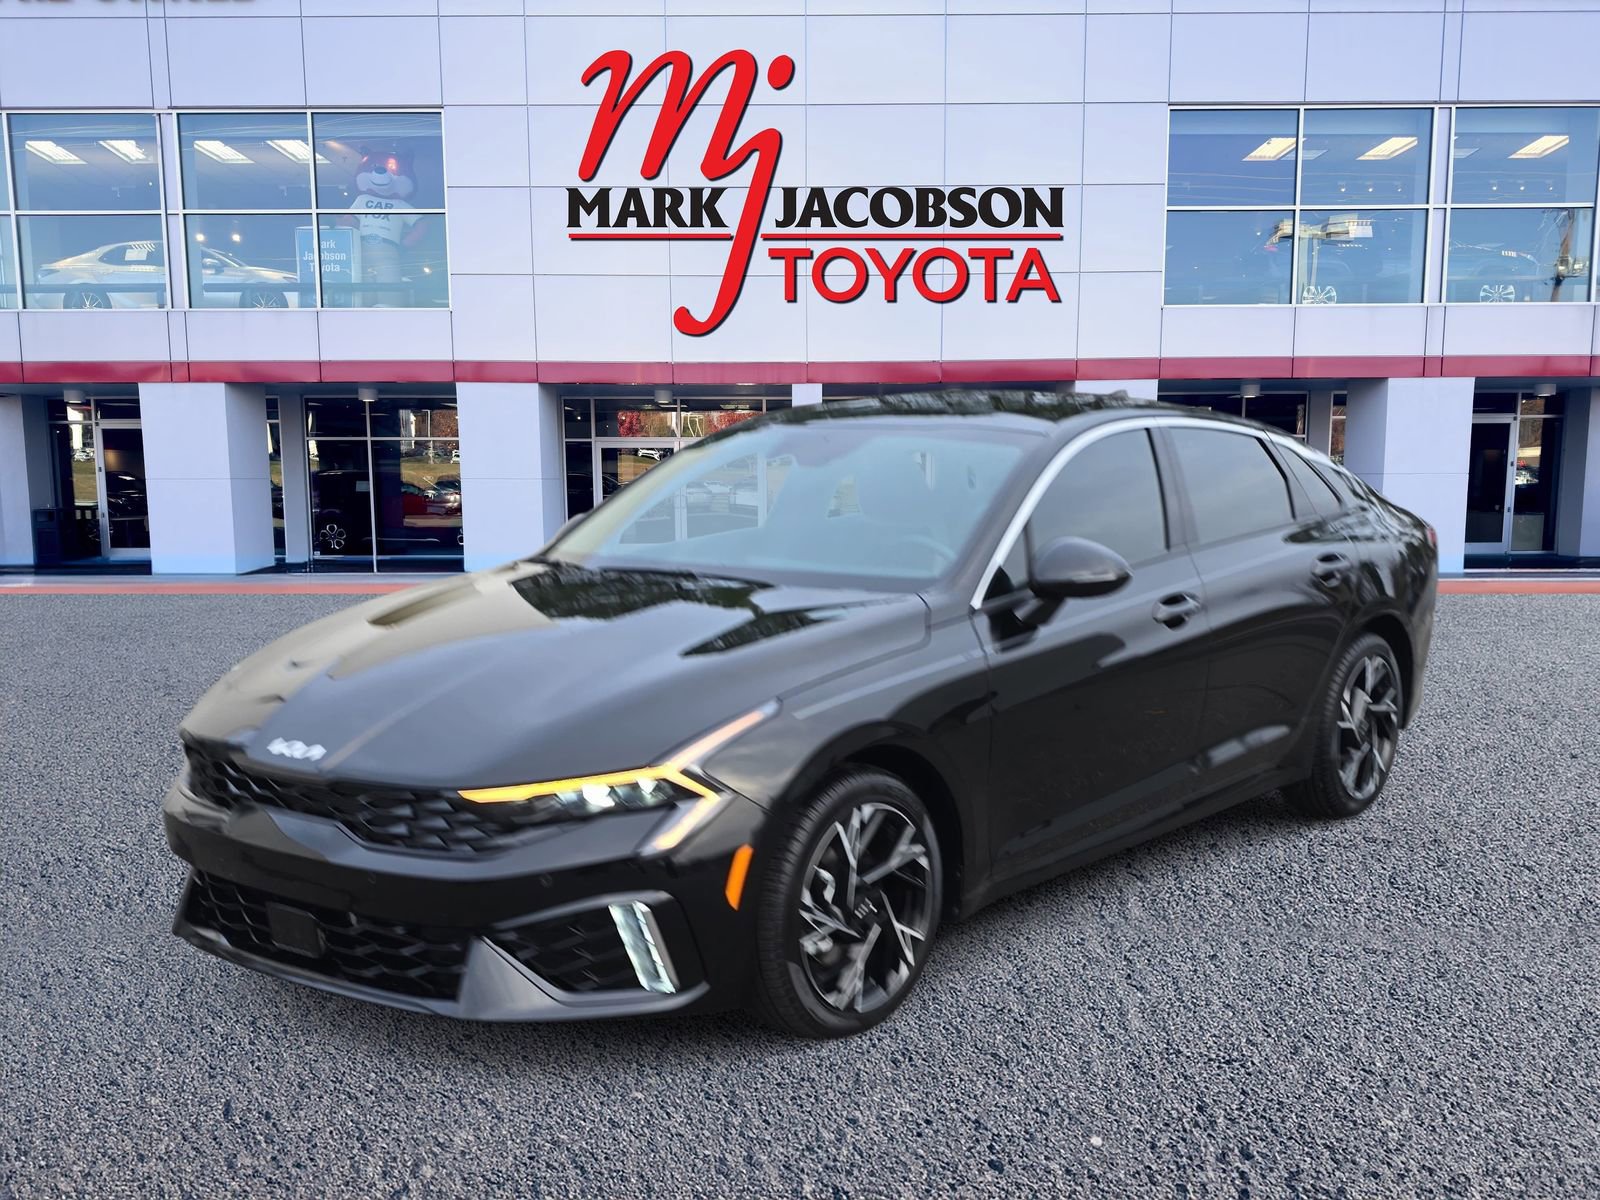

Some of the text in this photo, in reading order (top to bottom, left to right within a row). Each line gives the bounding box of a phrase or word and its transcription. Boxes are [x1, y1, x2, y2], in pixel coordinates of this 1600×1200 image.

[365, 199, 394, 210] CAR
[565, 187, 1065, 229] MARK JACOBSON
[313, 239, 336, 249] ark
[303, 251, 346, 261] Jabson
[309, 262, 340, 273] Tyota
[768, 247, 1062, 304] TOYOTA
